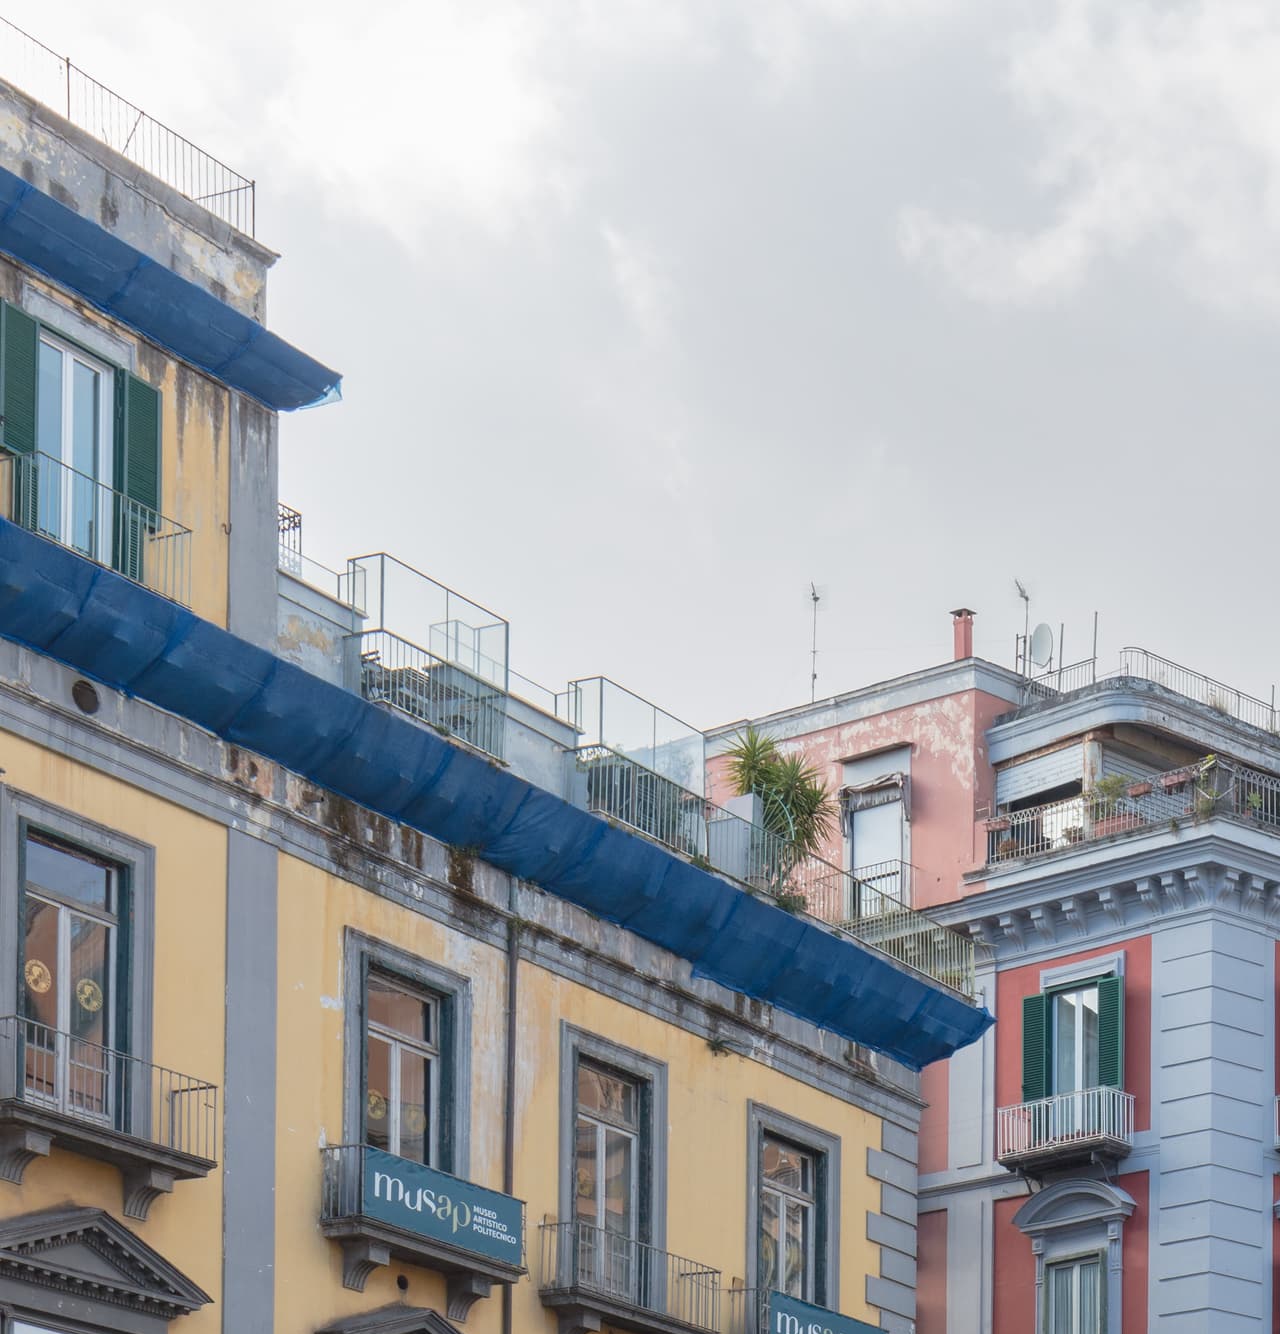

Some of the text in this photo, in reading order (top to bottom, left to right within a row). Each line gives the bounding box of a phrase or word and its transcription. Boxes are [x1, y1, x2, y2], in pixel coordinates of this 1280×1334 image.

[374, 1171, 472, 1234] musap
[473, 1205, 497, 1220] MUSEO
[473, 1215, 508, 1232] ARTISTICO
[473, 1225, 517, 1245] POLITECNICO
